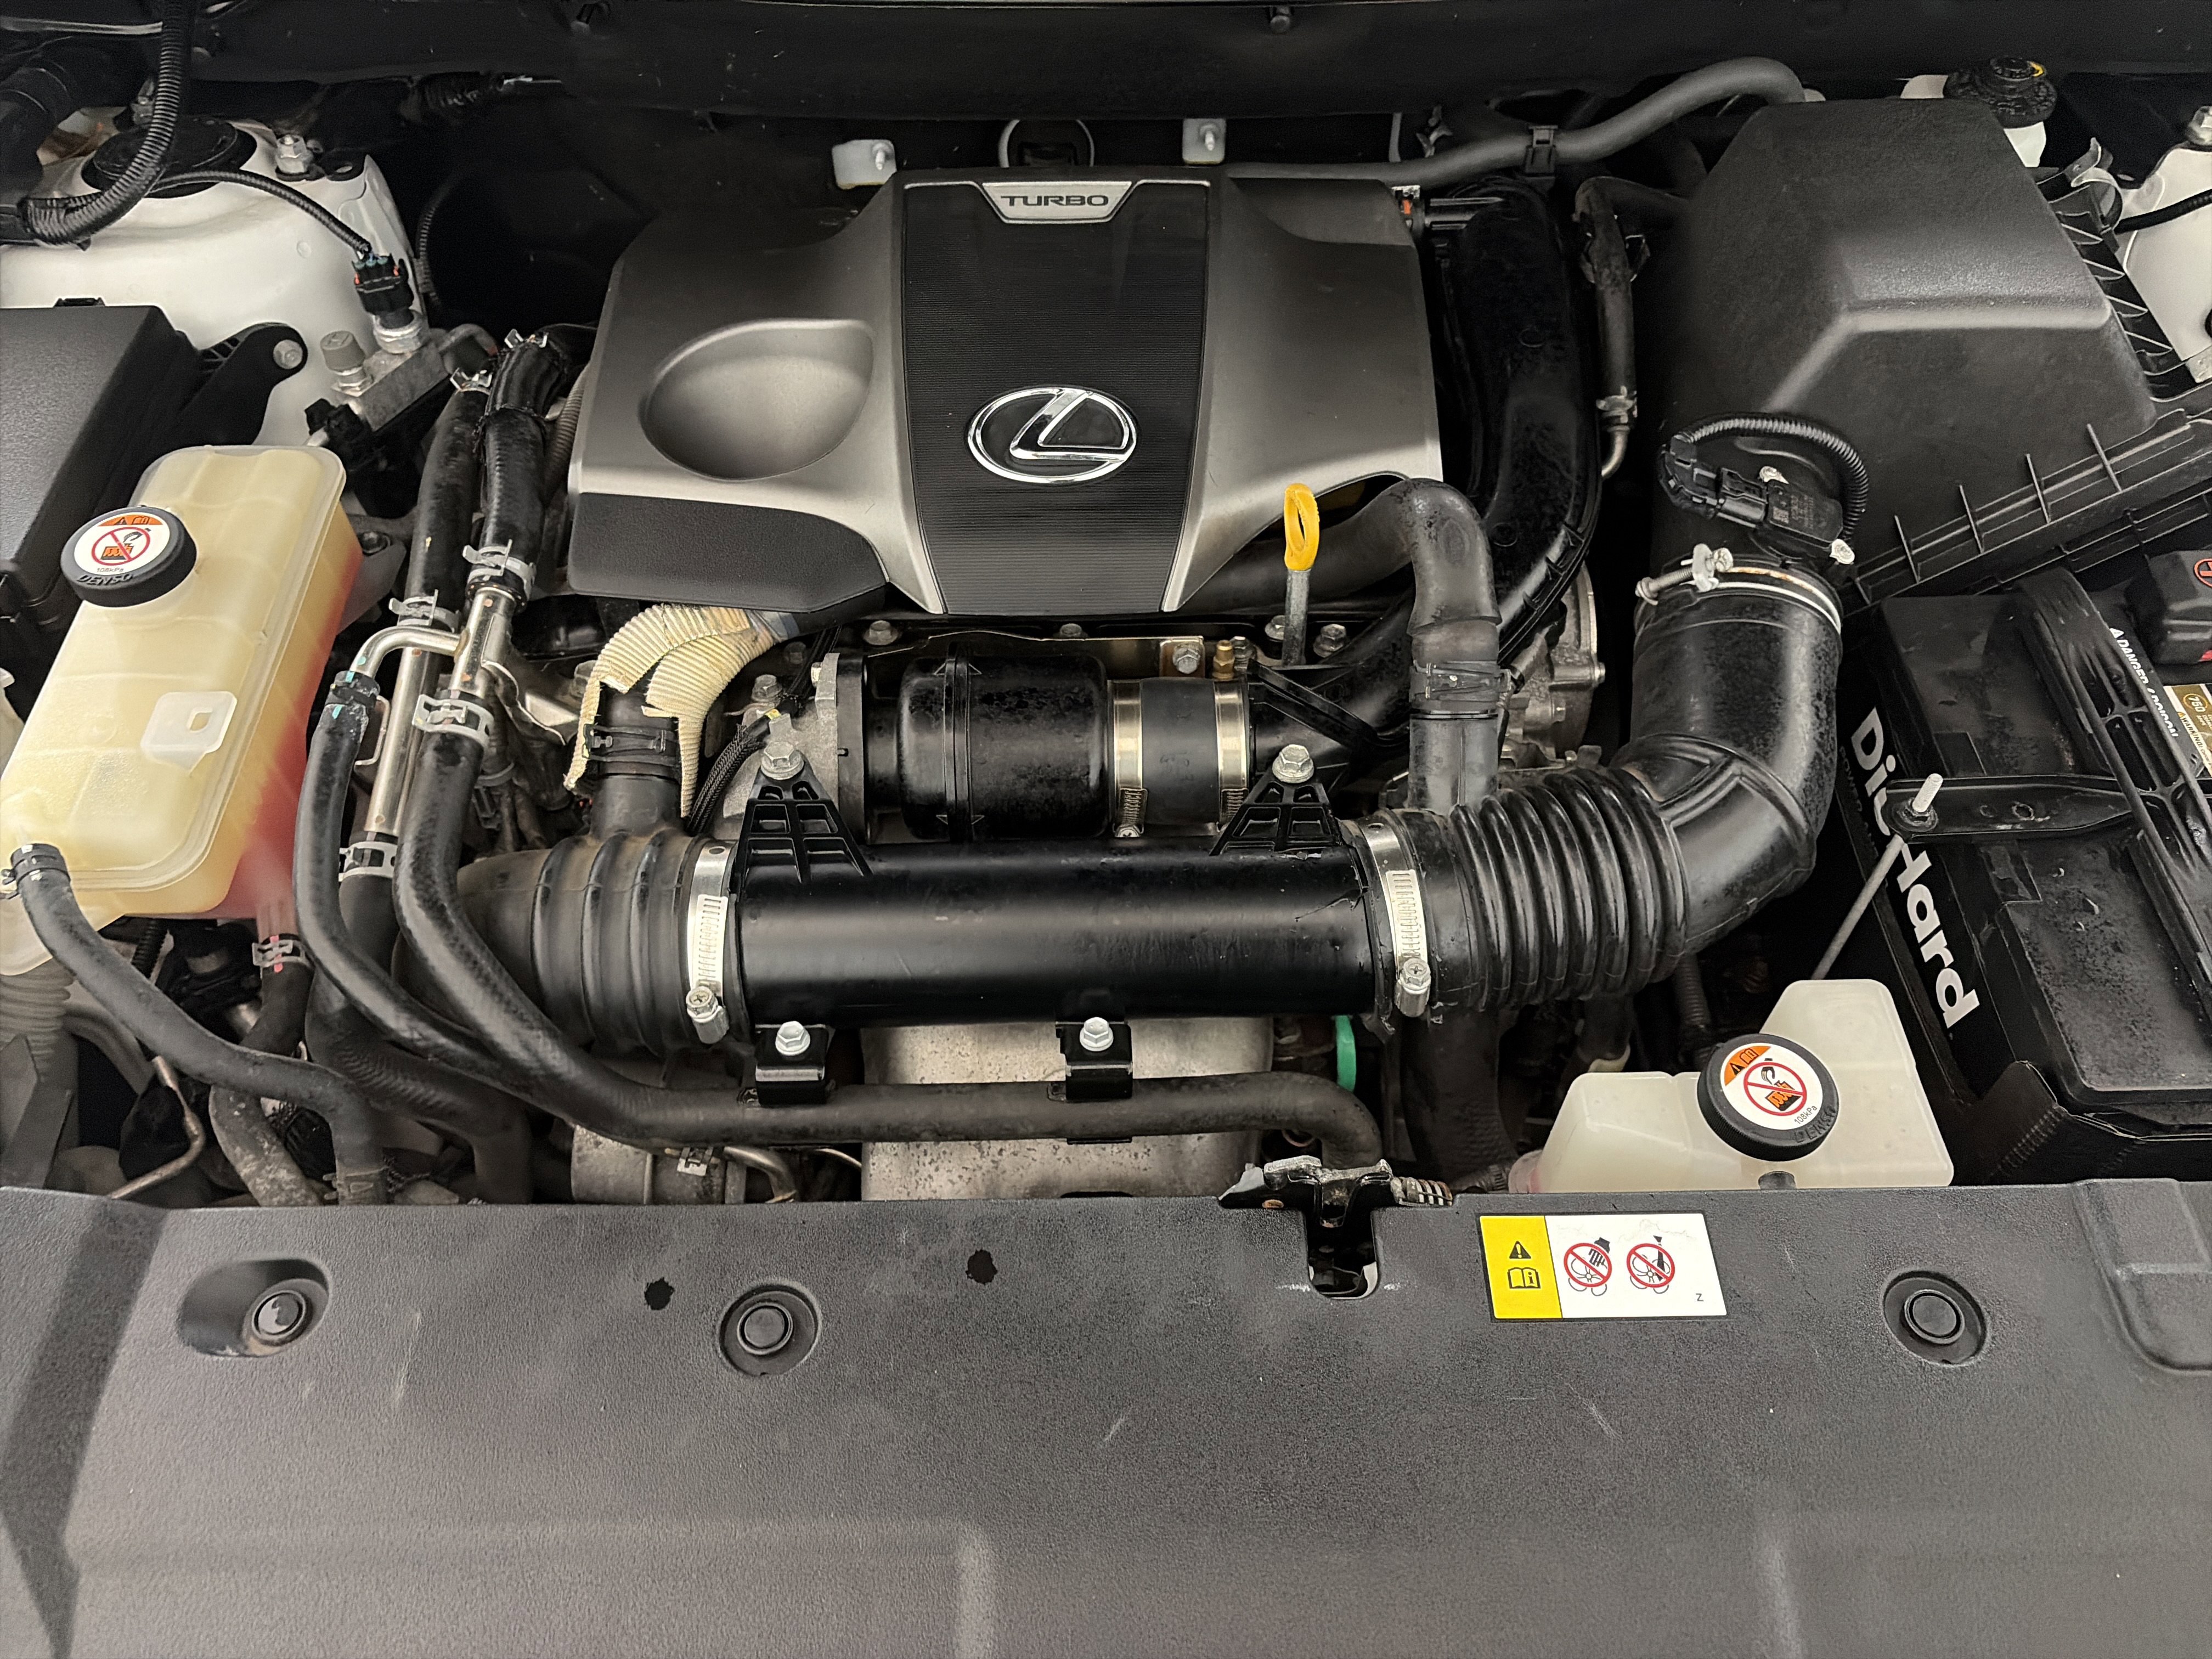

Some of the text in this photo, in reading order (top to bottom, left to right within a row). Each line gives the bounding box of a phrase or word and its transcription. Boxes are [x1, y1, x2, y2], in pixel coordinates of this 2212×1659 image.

[1001, 195, 1109, 206] TURBO
[76, 572, 134, 586] DENSO
[2188, 696, 2206, 713] 750
[1794, 1104, 1818, 1125] 108kPa
[1794, 1106, 1836, 1143] DENSO
[1695, 1293, 1705, 1302] Z
